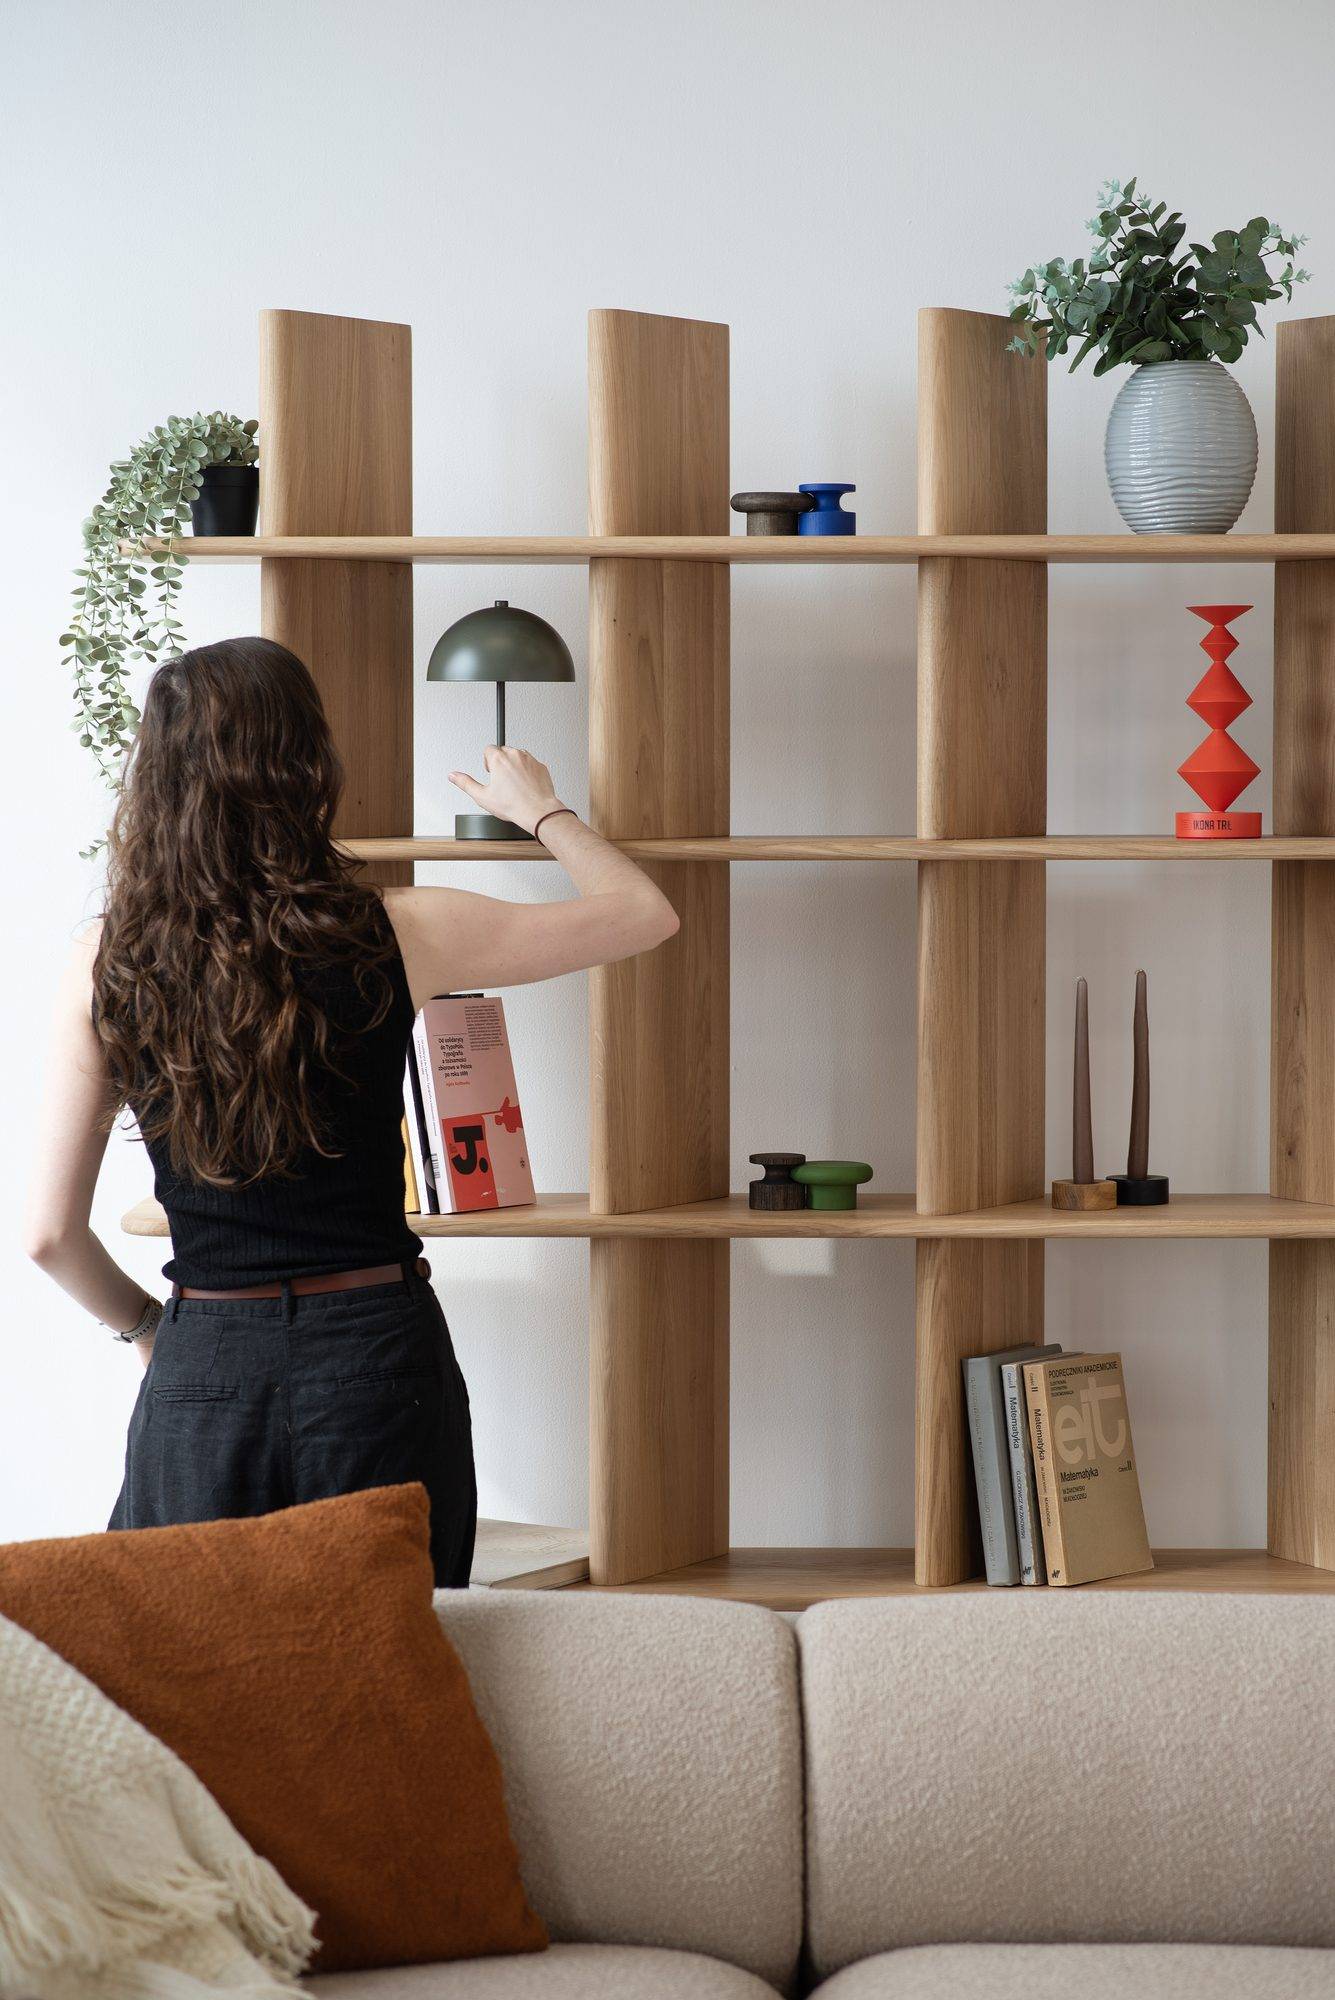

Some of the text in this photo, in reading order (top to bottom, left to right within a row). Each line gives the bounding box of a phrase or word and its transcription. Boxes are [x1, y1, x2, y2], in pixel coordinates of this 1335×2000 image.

[1193, 820, 1215, 831] IKONA
[1009, 1397, 1021, 1449] Matematyka
[1034, 1408, 1046, 1461] Matematyka
[1060, 1467, 1099, 1482] Matematyka
